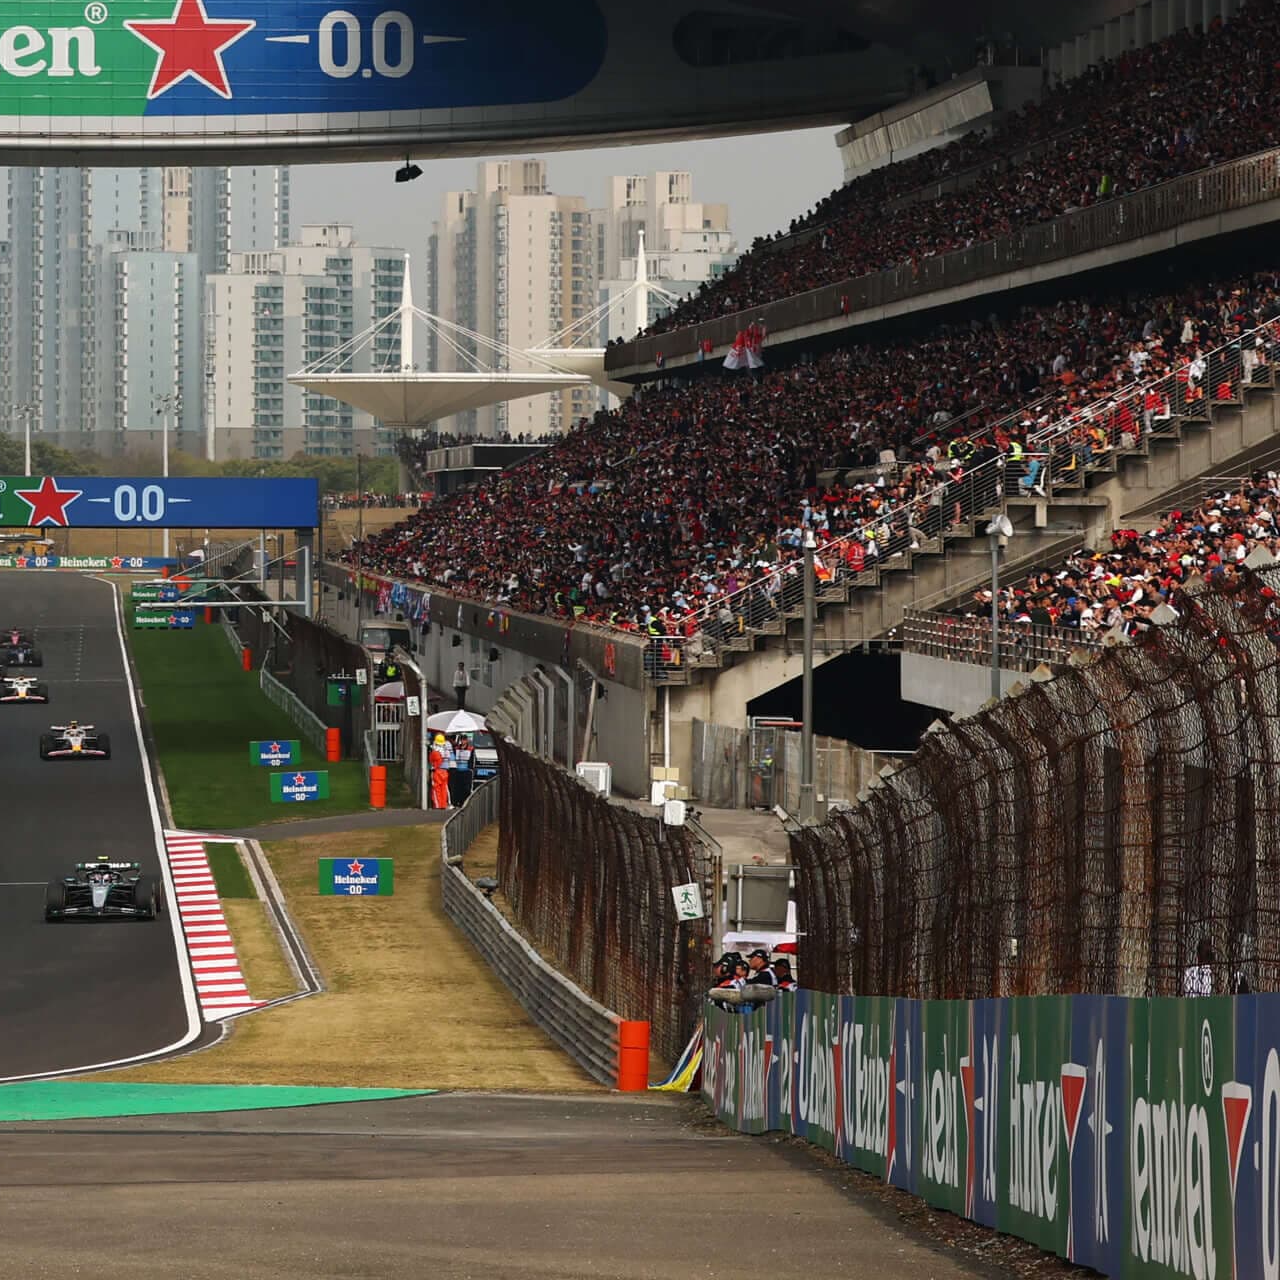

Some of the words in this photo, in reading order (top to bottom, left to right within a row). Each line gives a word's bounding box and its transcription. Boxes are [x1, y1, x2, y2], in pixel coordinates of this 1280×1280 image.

[318, 10, 415, 78] 0.0
[113, 484, 165, 521] 0.0
[334, 875, 378, 884] Heineken
